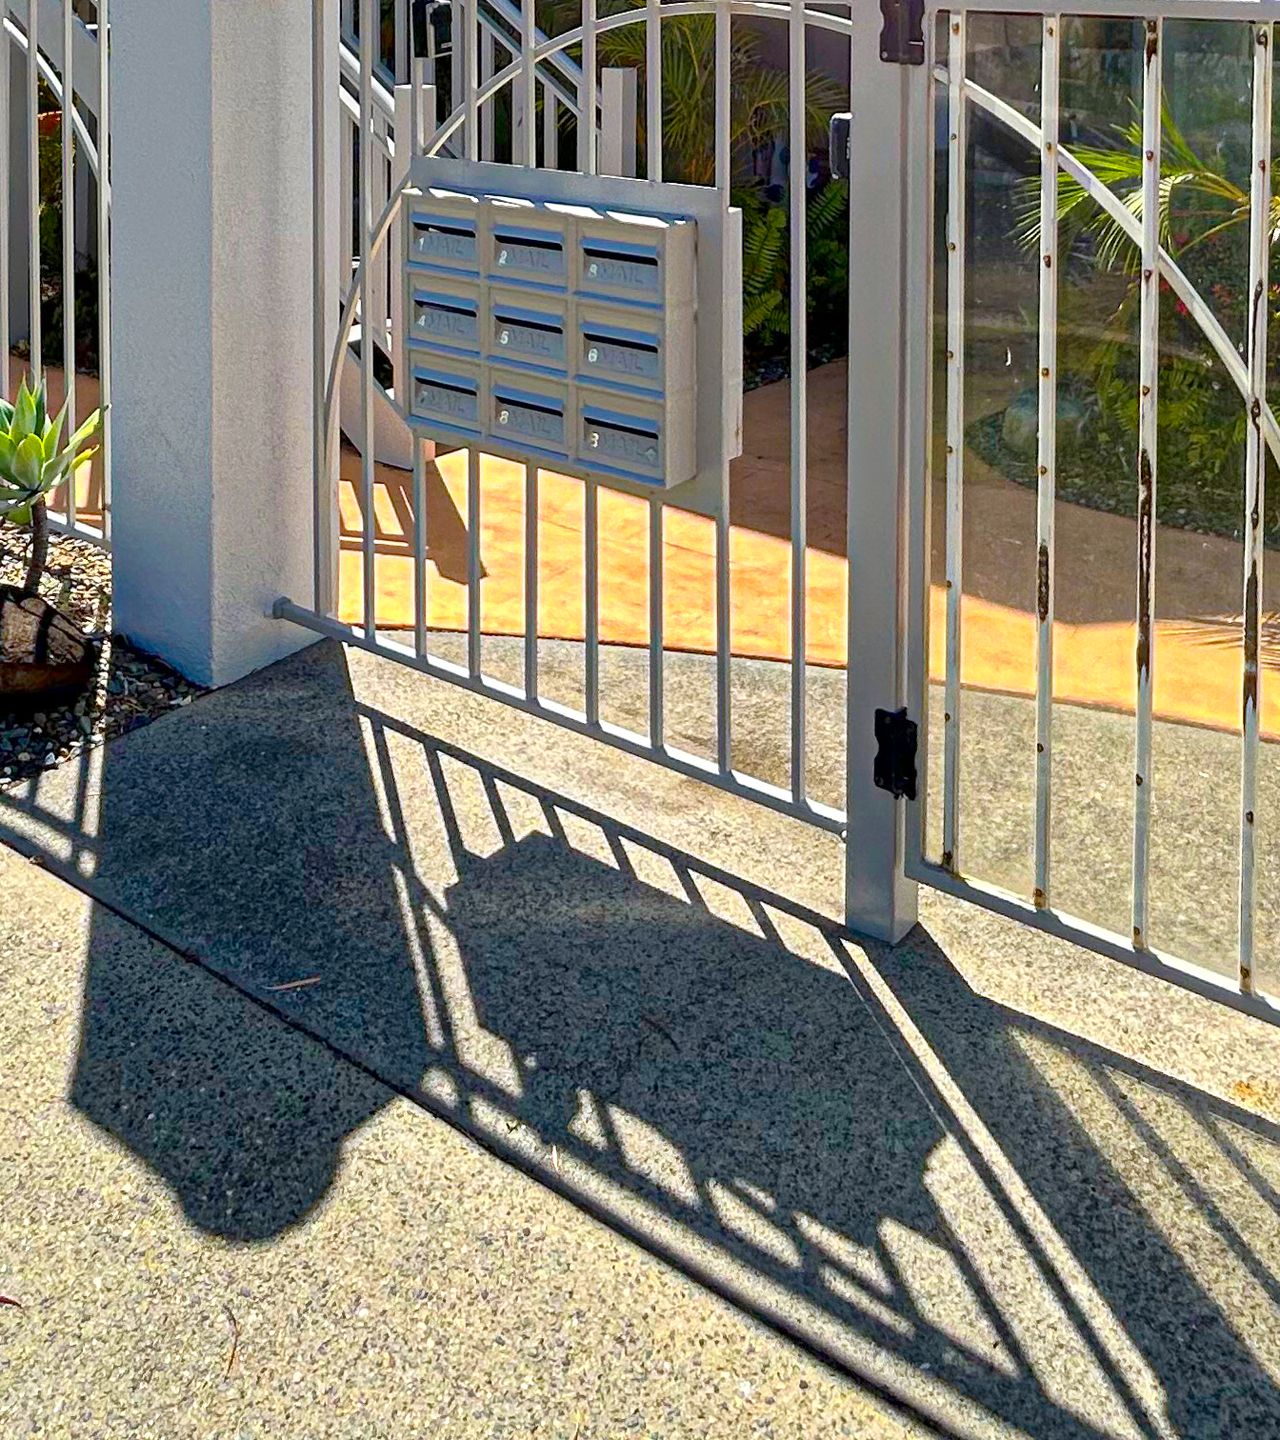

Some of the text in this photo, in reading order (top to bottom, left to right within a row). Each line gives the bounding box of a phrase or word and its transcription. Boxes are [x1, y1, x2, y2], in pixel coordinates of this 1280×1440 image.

[419, 237, 425, 251] 1
[498, 249, 508, 266] 2
[418, 314, 426, 327] 4
[500, 330, 509, 345] 5
[588, 348, 598, 362] 6
[500, 410, 509, 425] 8
